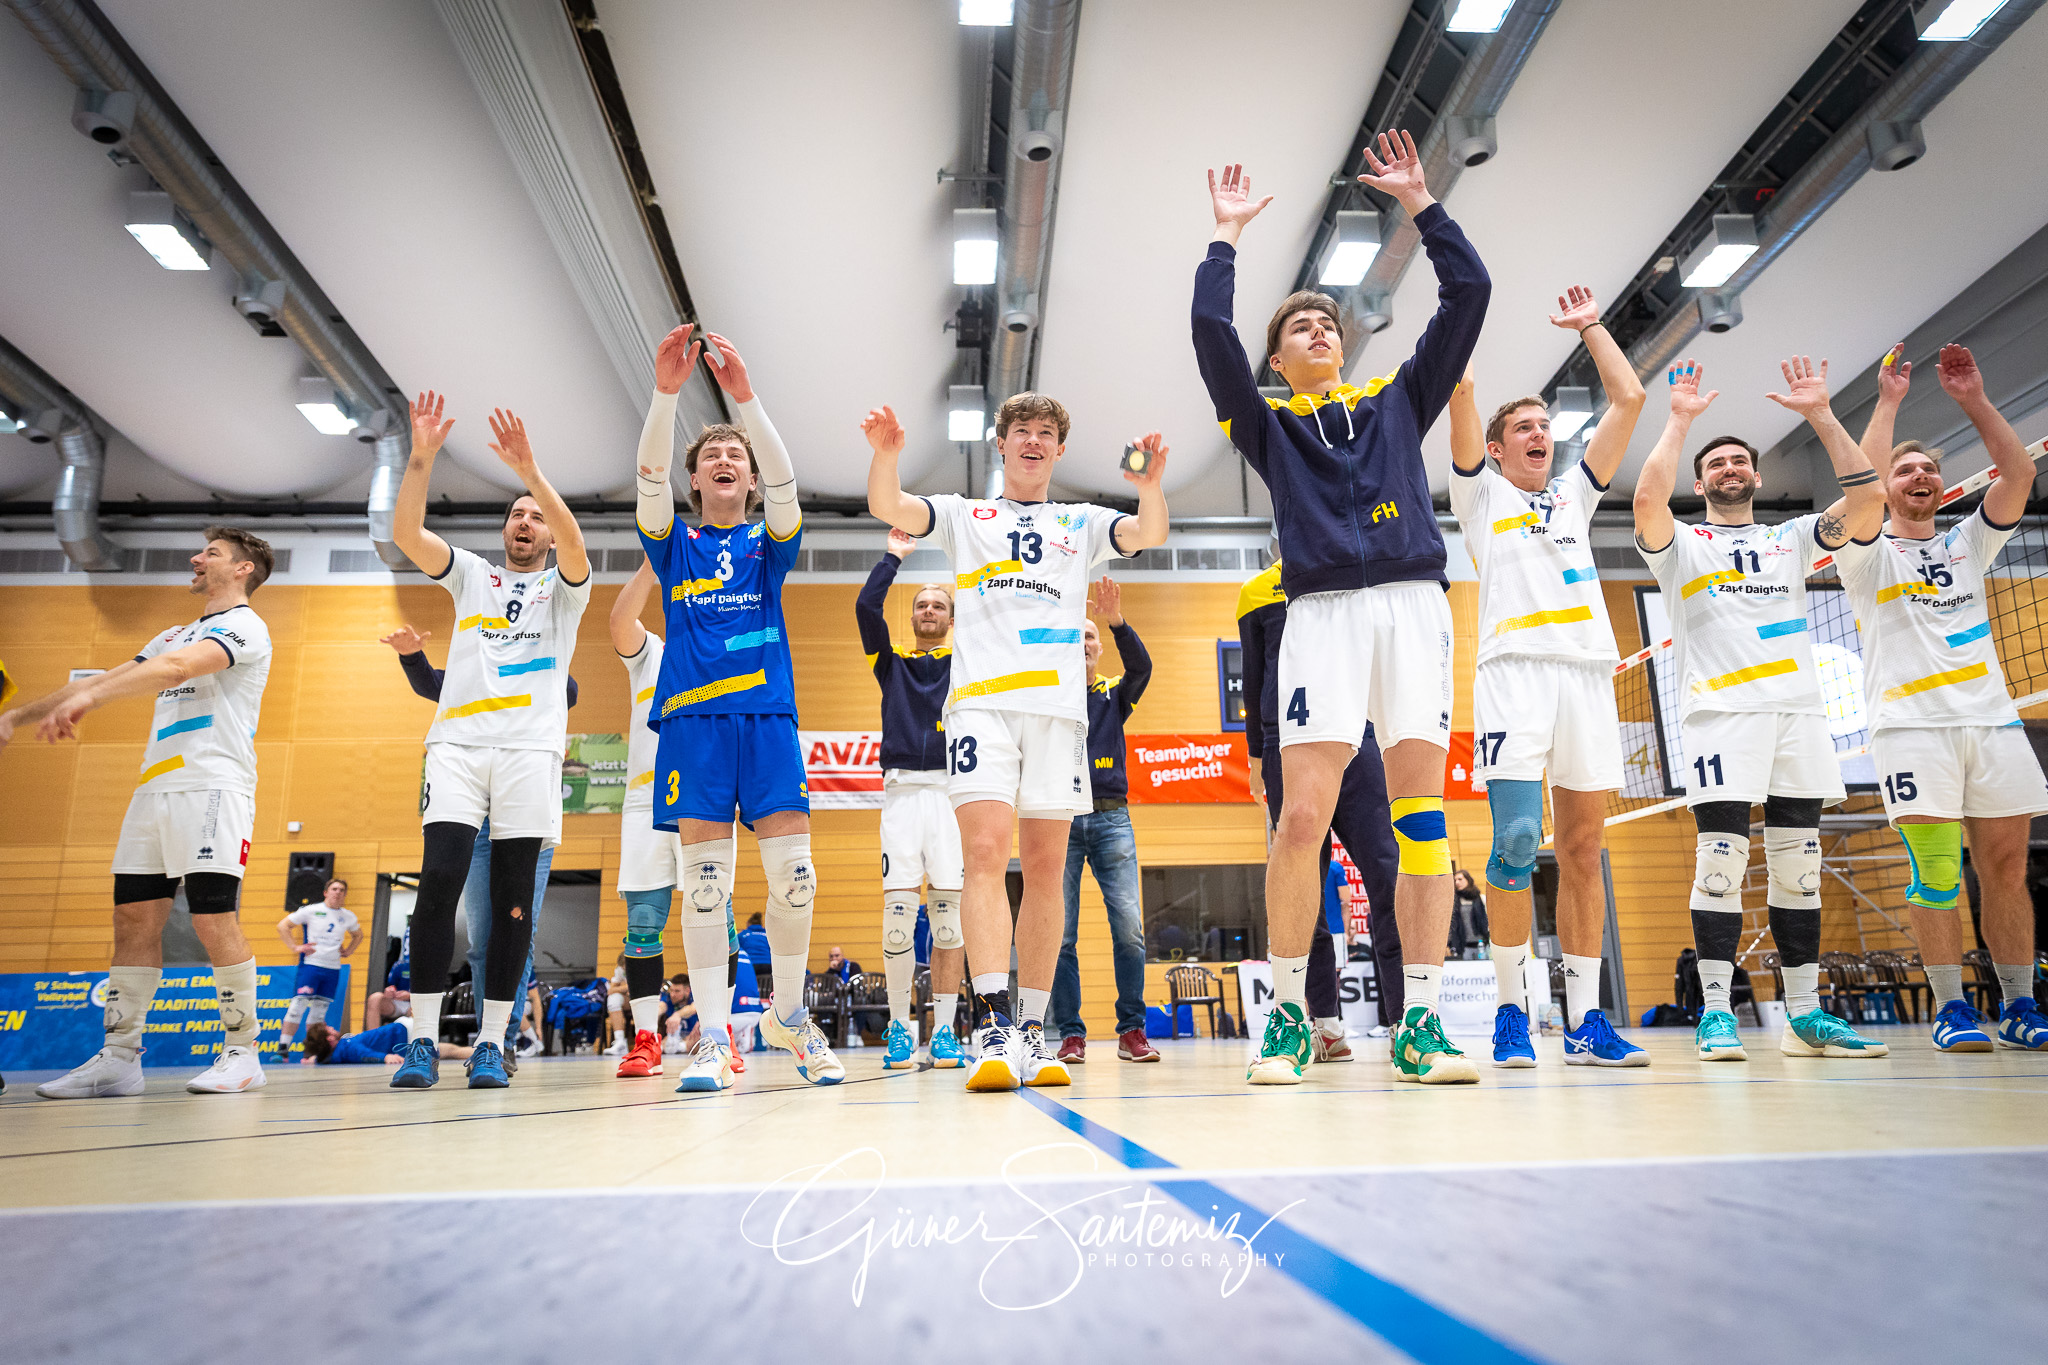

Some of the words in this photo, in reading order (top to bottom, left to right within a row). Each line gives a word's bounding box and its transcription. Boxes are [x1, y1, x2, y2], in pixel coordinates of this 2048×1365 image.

[1372, 501, 1399, 523] FH
[1007, 531, 1043, 564] 13
[714, 549, 734, 582] 3
[1728, 549, 1761, 574] 11
[1917, 563, 1953, 588] 15
[987, 577, 1015, 589] Zapf
[1016, 579, 1062, 600] Daigfuss
[1718, 584, 1743, 596] Zapf
[1745, 584, 1789, 596] Daigfuss
[506, 600, 523, 623] 8
[225, 631, 246, 648] puls
[1227, 678, 1243, 692] H
[1287, 687, 1310, 727] 4
[807, 735, 882, 766] AVIA
[949, 735, 978, 776] 13
[1134, 742, 1232, 764] Teamplayer
[1480, 731, 1507, 767] 17
[1150, 761, 1223, 787] gesucht!
[1693, 754, 1724, 788] 11
[666, 770, 680, 806] 3
[1885, 772, 1918, 804] 15
[158, 977, 189, 988] CHTE
